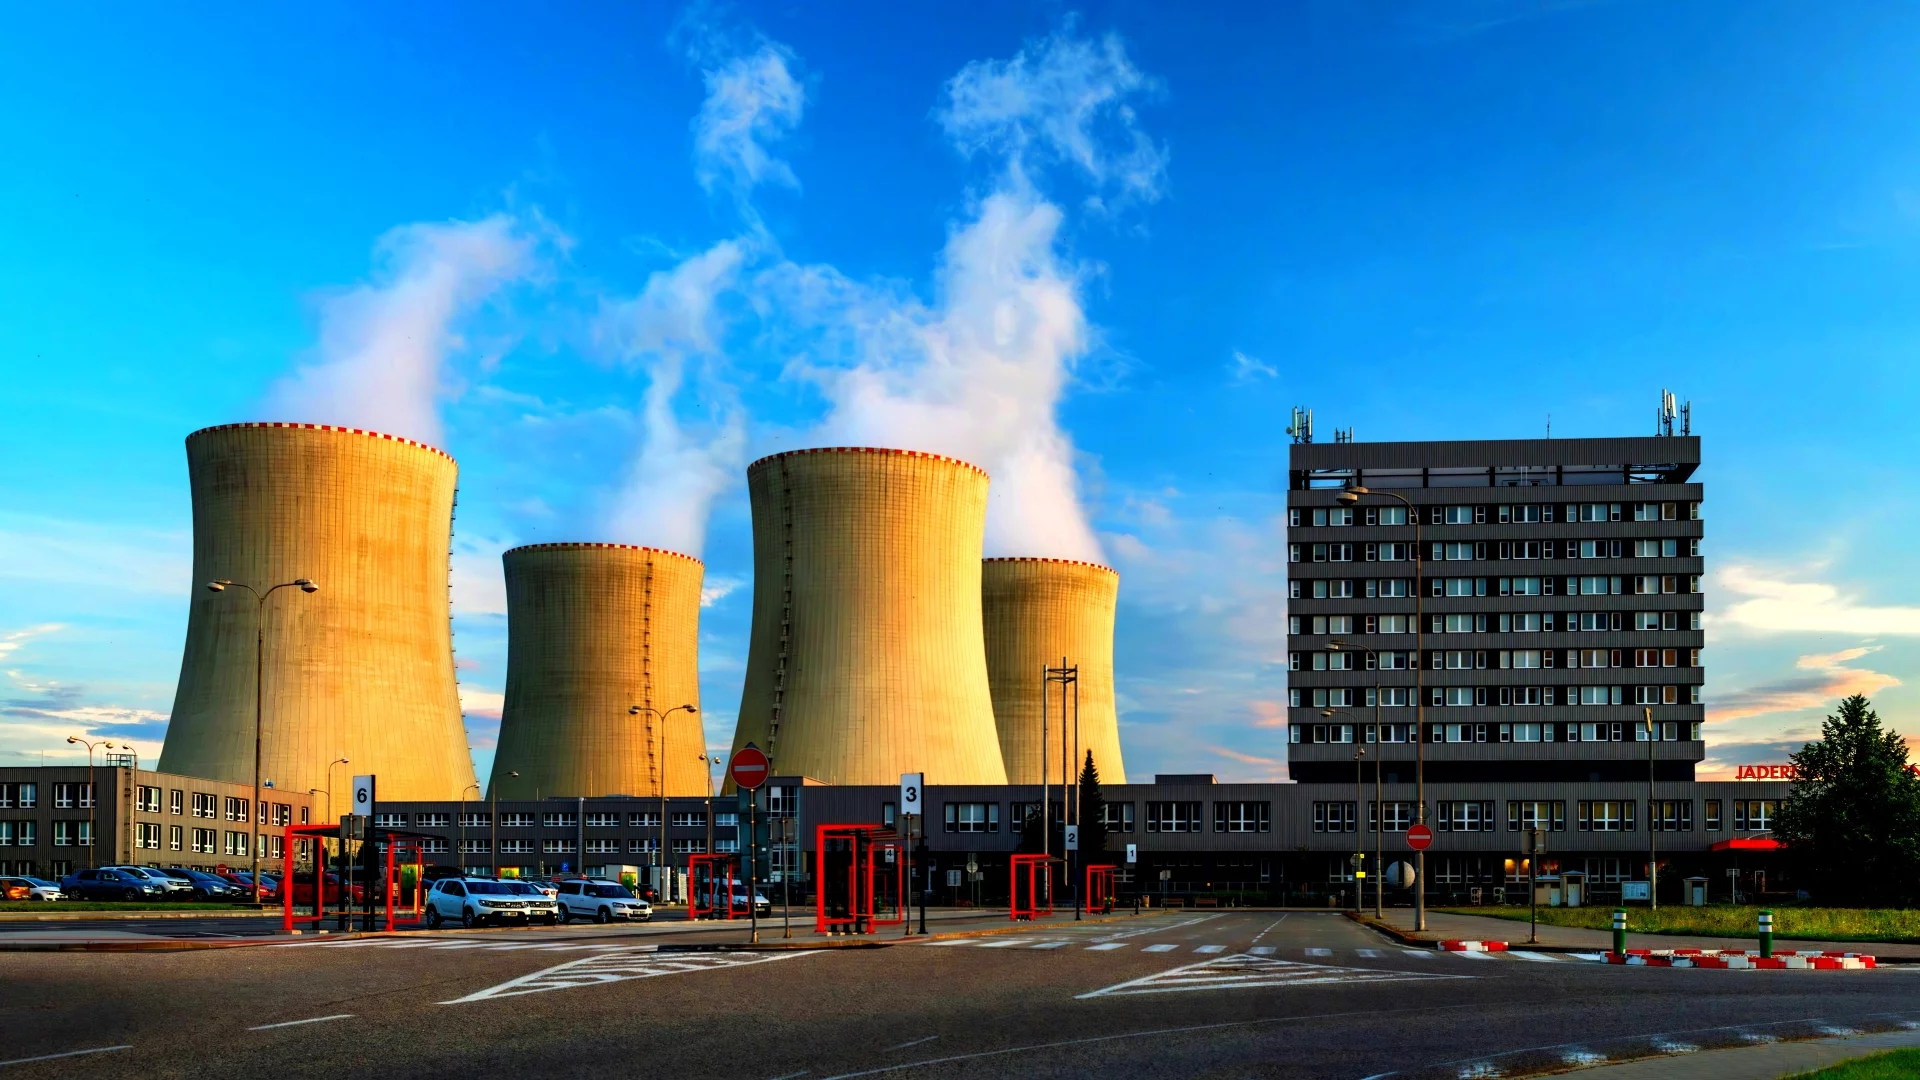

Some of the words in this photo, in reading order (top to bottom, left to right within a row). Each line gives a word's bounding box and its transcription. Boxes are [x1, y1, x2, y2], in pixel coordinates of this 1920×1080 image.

[357, 787, 367, 803] 6
[905, 786, 917, 802] 3
[1068, 833, 1075, 842] 2
[886, 849, 893, 857] 4
[1130, 849, 1134, 857] 1
